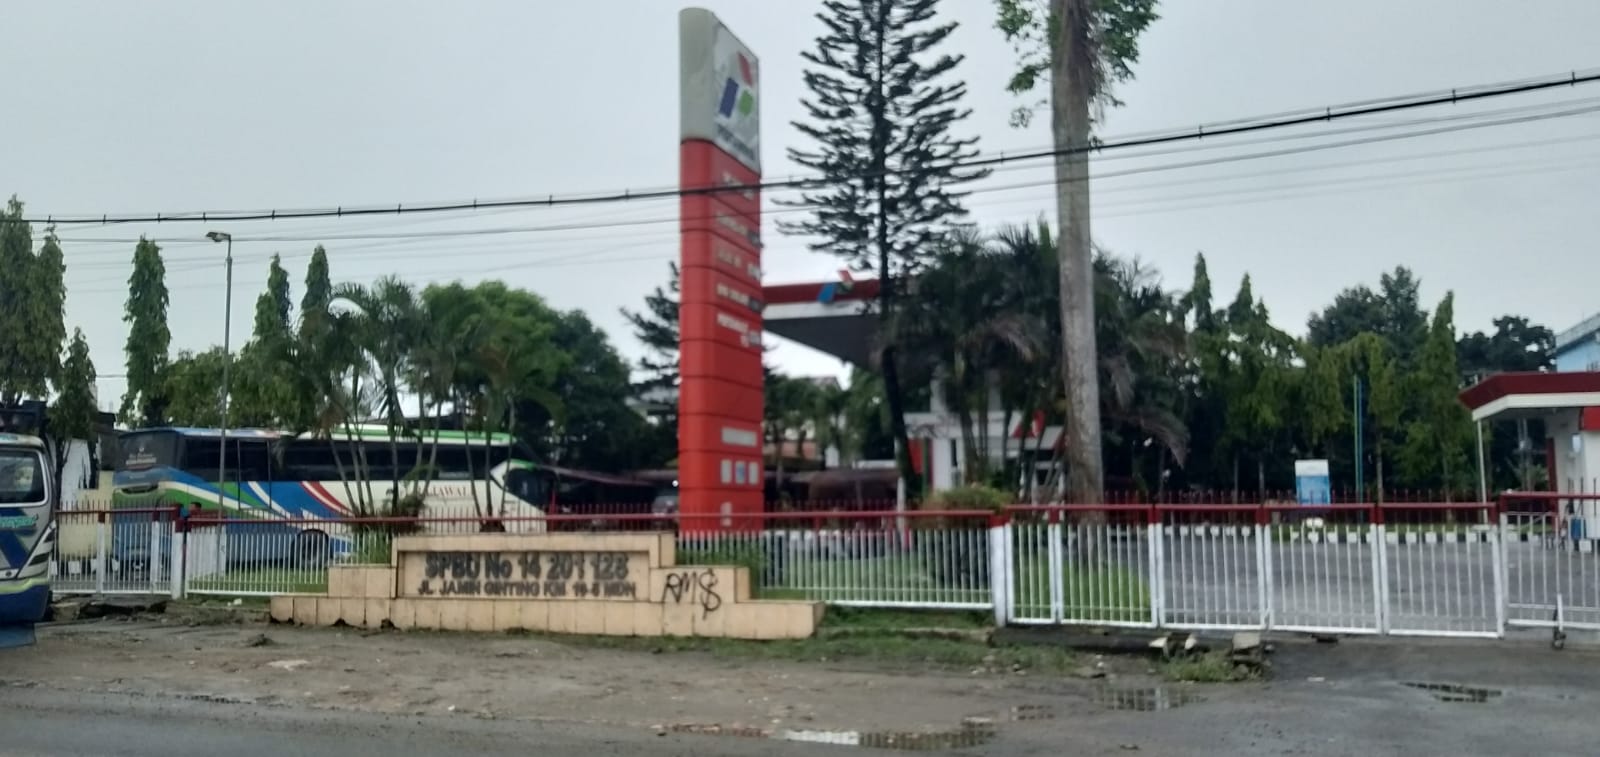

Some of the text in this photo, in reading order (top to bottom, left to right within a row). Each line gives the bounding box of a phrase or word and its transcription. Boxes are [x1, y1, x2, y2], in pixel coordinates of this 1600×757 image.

[425, 552, 629, 580] SPBU No 14 201 128
[439, 580, 481, 595] JAMIN
[484, 581, 540, 597] GINTING
